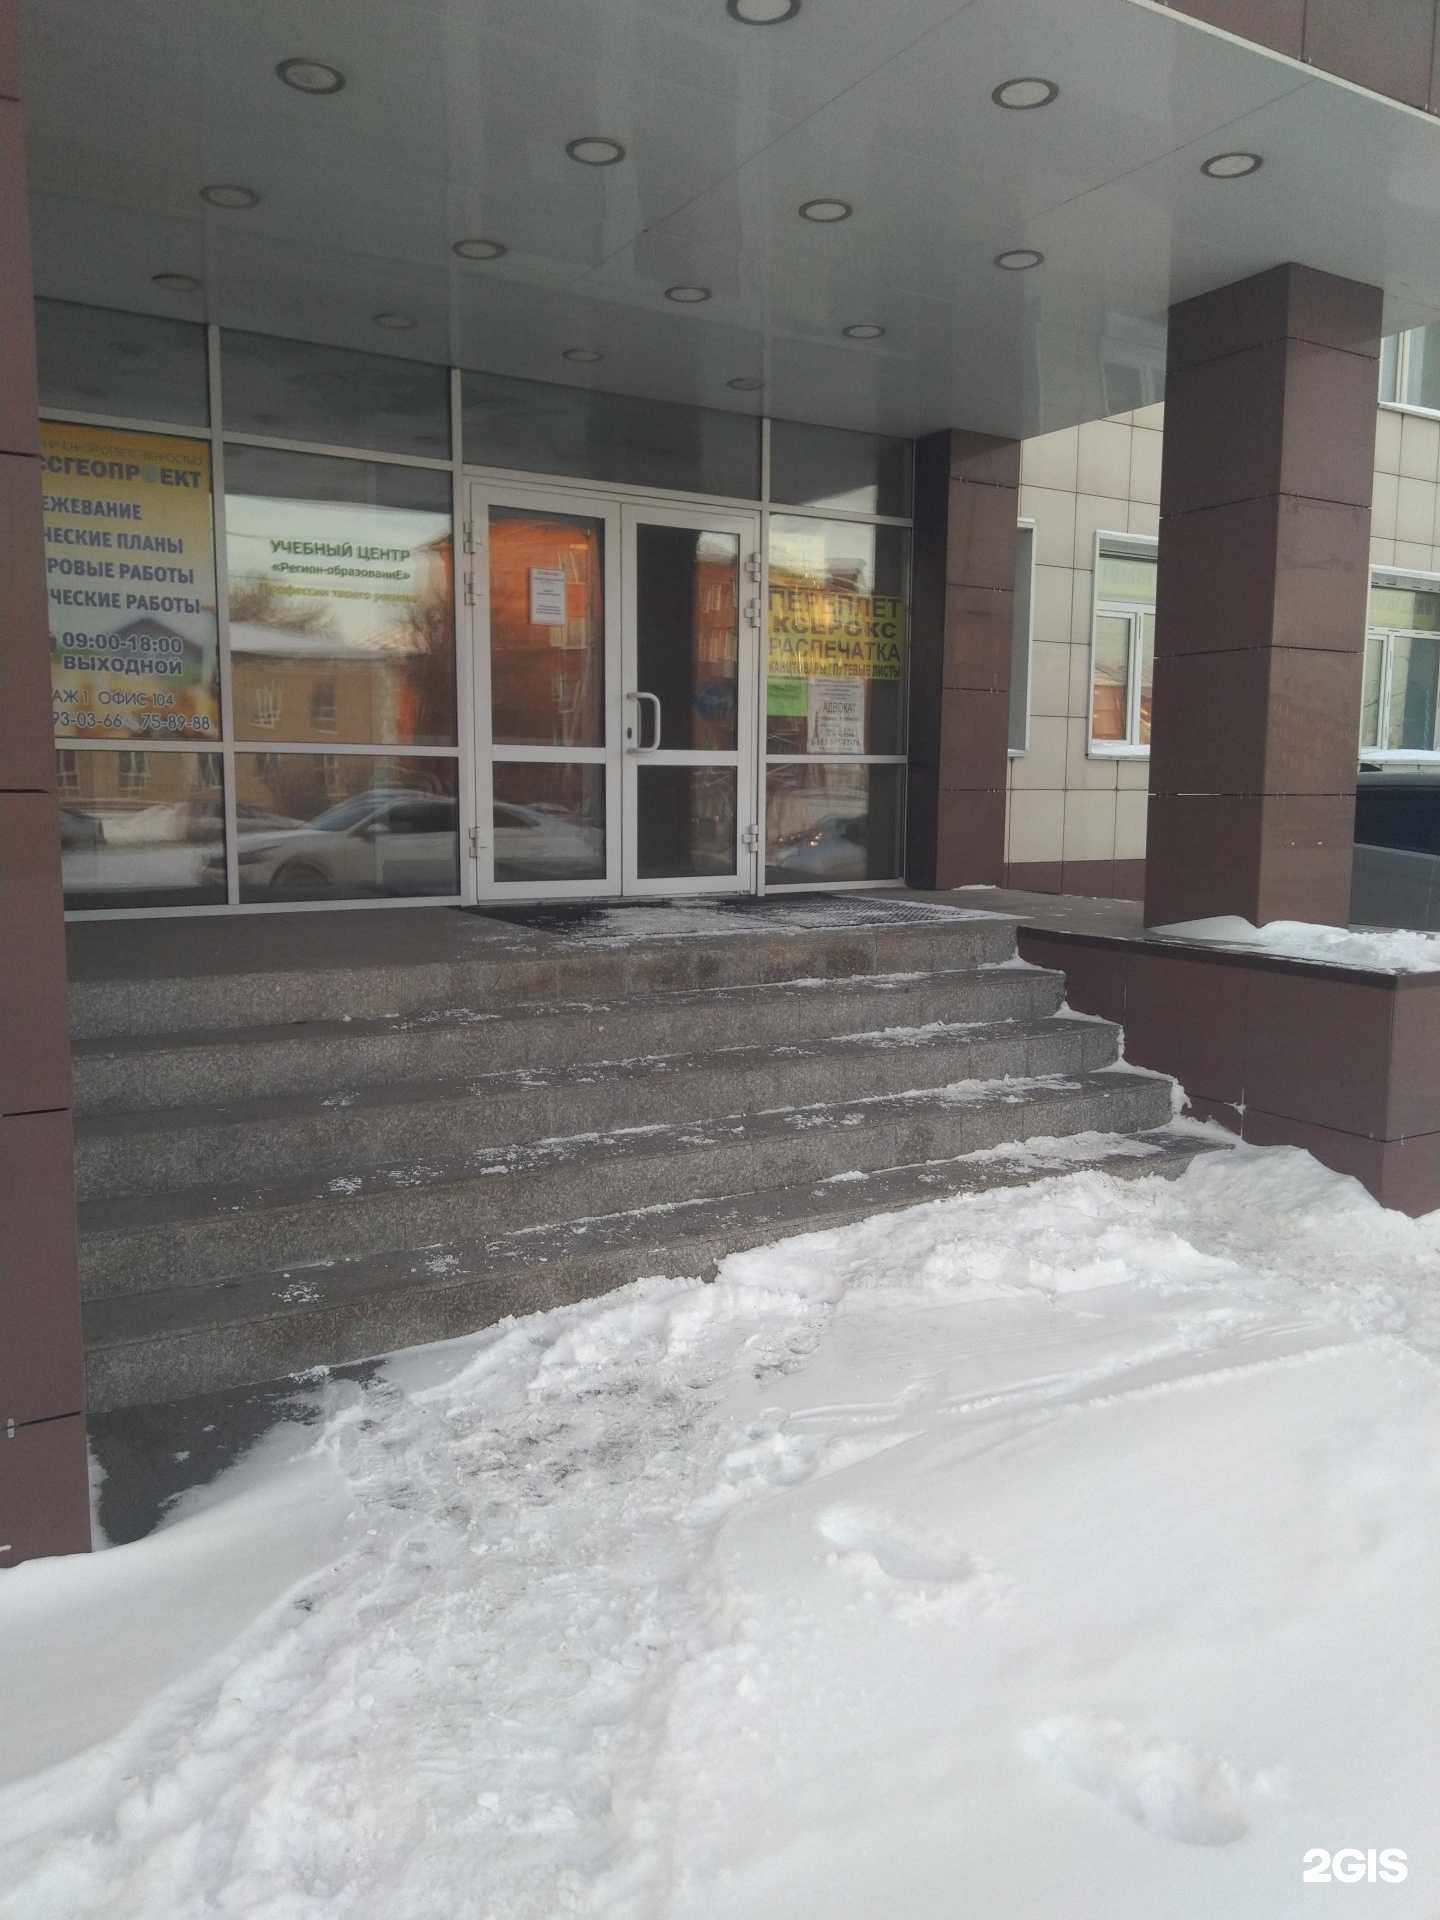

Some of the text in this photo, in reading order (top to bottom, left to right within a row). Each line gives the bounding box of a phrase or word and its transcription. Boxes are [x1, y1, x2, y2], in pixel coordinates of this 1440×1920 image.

[117, 533, 183, 554] ПЛАНЫ
[270, 539, 410, 562] УЧЕБНЫЙ ЦЕНТР
[47, 557, 194, 585] РОВЫЕ РАБОТЫ
[50, 588, 200, 615] ЧЕСКИЕ РАБОТЫ
[773, 615, 897, 639] КСЕРОКС
[62, 631, 183, 653] 09:00-18:00
[769, 637, 901, 662] РАСПЕЧАТКА
[63, 655, 182, 676] ВЫХОДНОЙ
[98, 690, 147, 706] ОФИС
[152, 692, 176, 706] 104
[142, 714, 209, 730] 75-89-88
